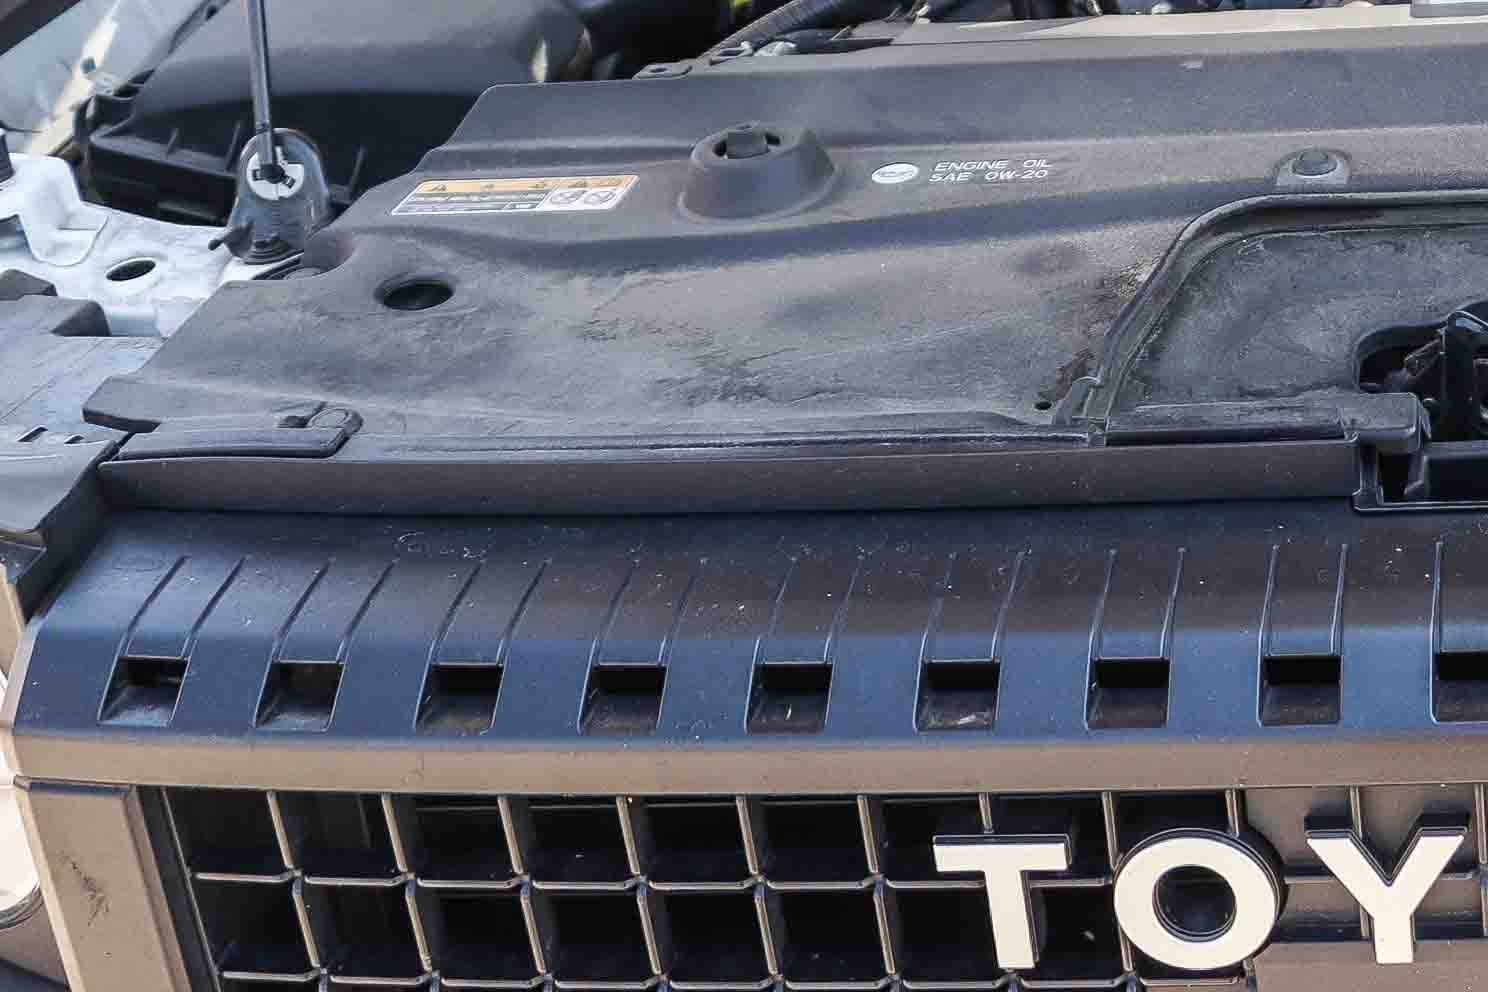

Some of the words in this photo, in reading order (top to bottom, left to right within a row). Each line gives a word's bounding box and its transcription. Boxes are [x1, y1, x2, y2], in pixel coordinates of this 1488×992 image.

[934, 159, 1009, 172] ENGINE
[1022, 159, 1054, 168] OIL
[928, 171, 973, 183] SAE
